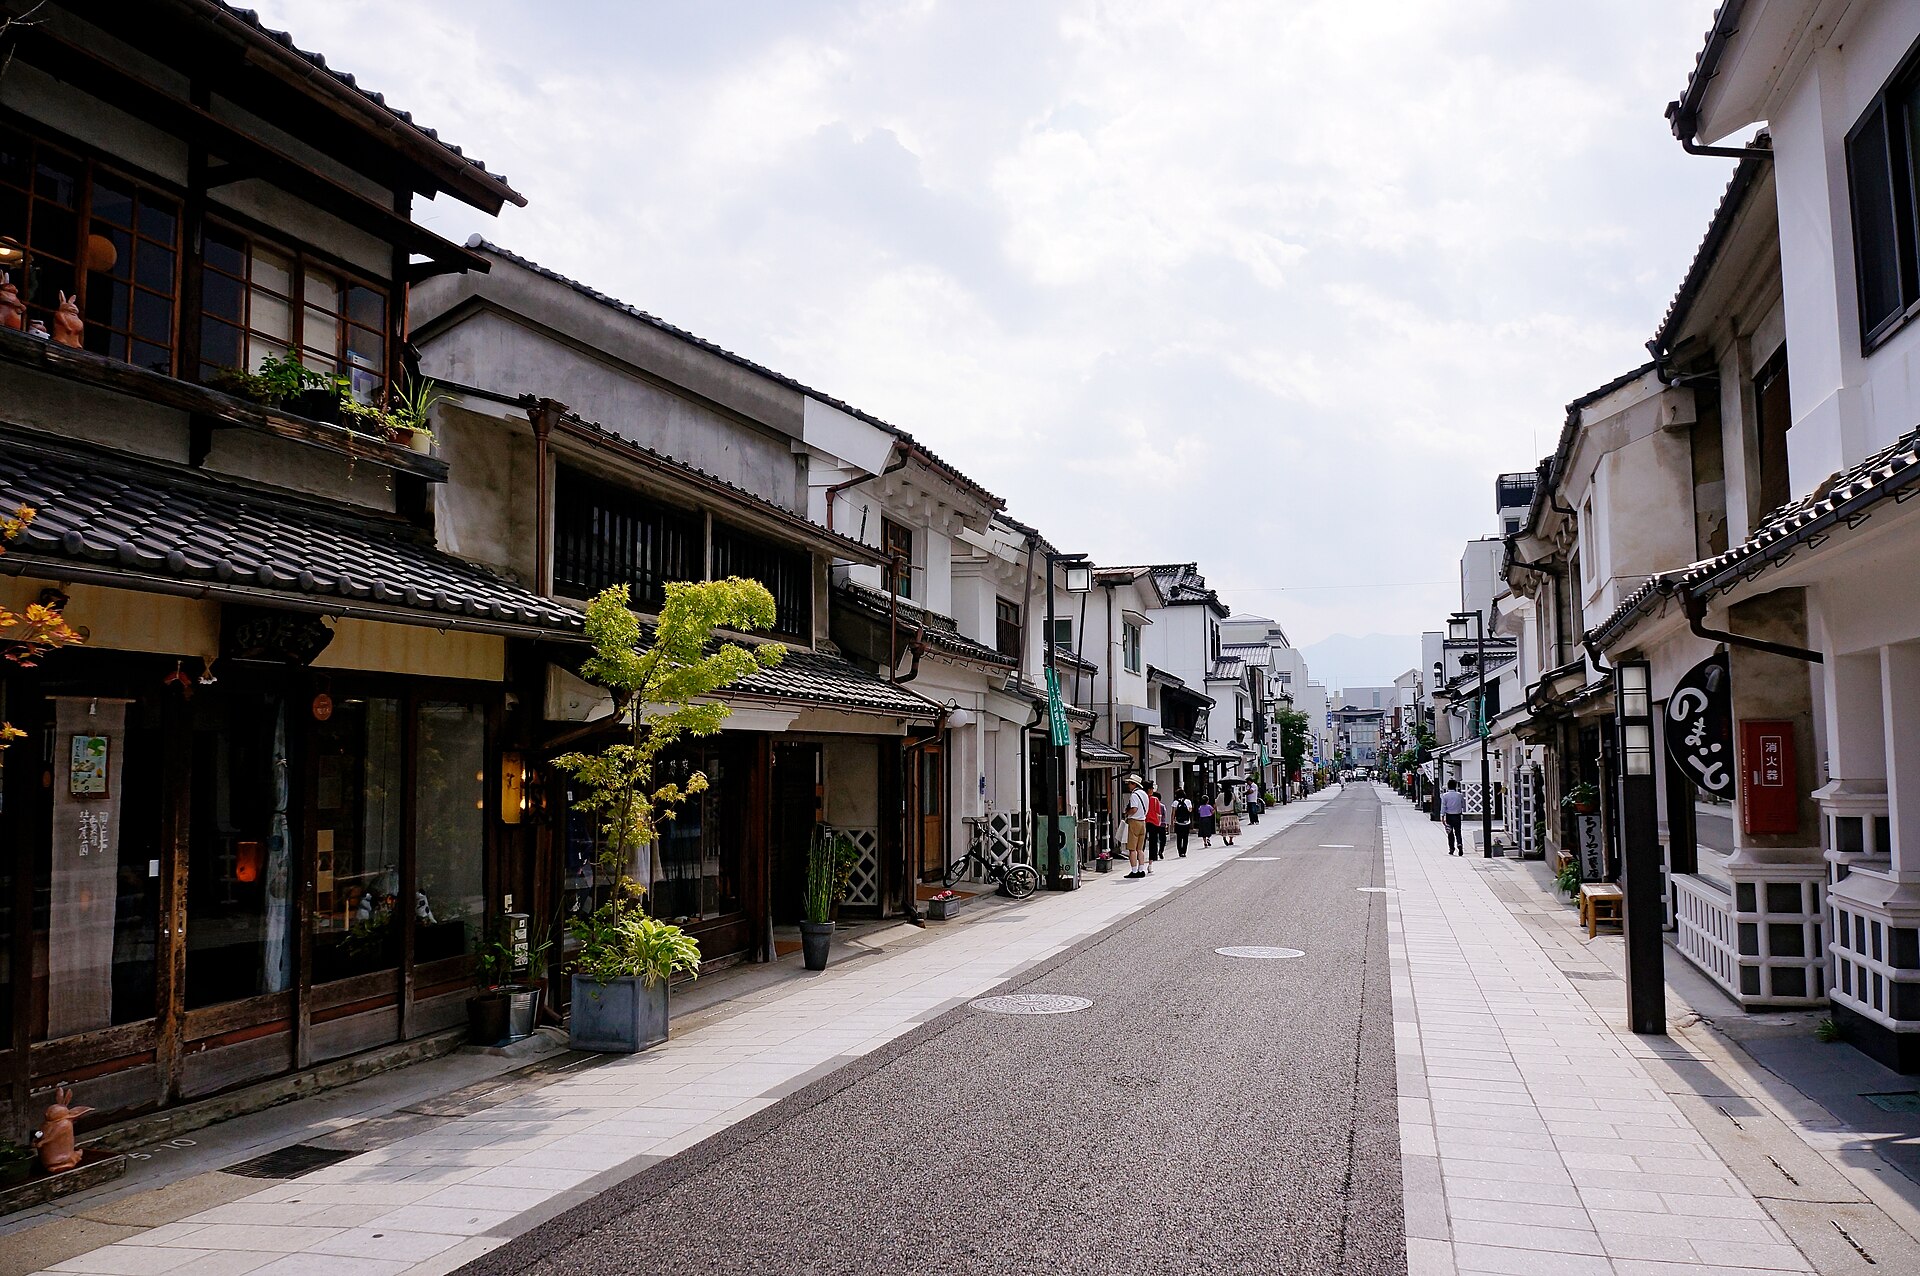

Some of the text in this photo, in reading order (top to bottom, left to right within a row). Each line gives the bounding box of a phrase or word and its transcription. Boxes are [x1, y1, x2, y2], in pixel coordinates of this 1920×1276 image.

[1669, 686, 1731, 791] のまど
[1765, 742, 1779, 781] 消火器
[127, 1138, 198, 1161] 5-10
